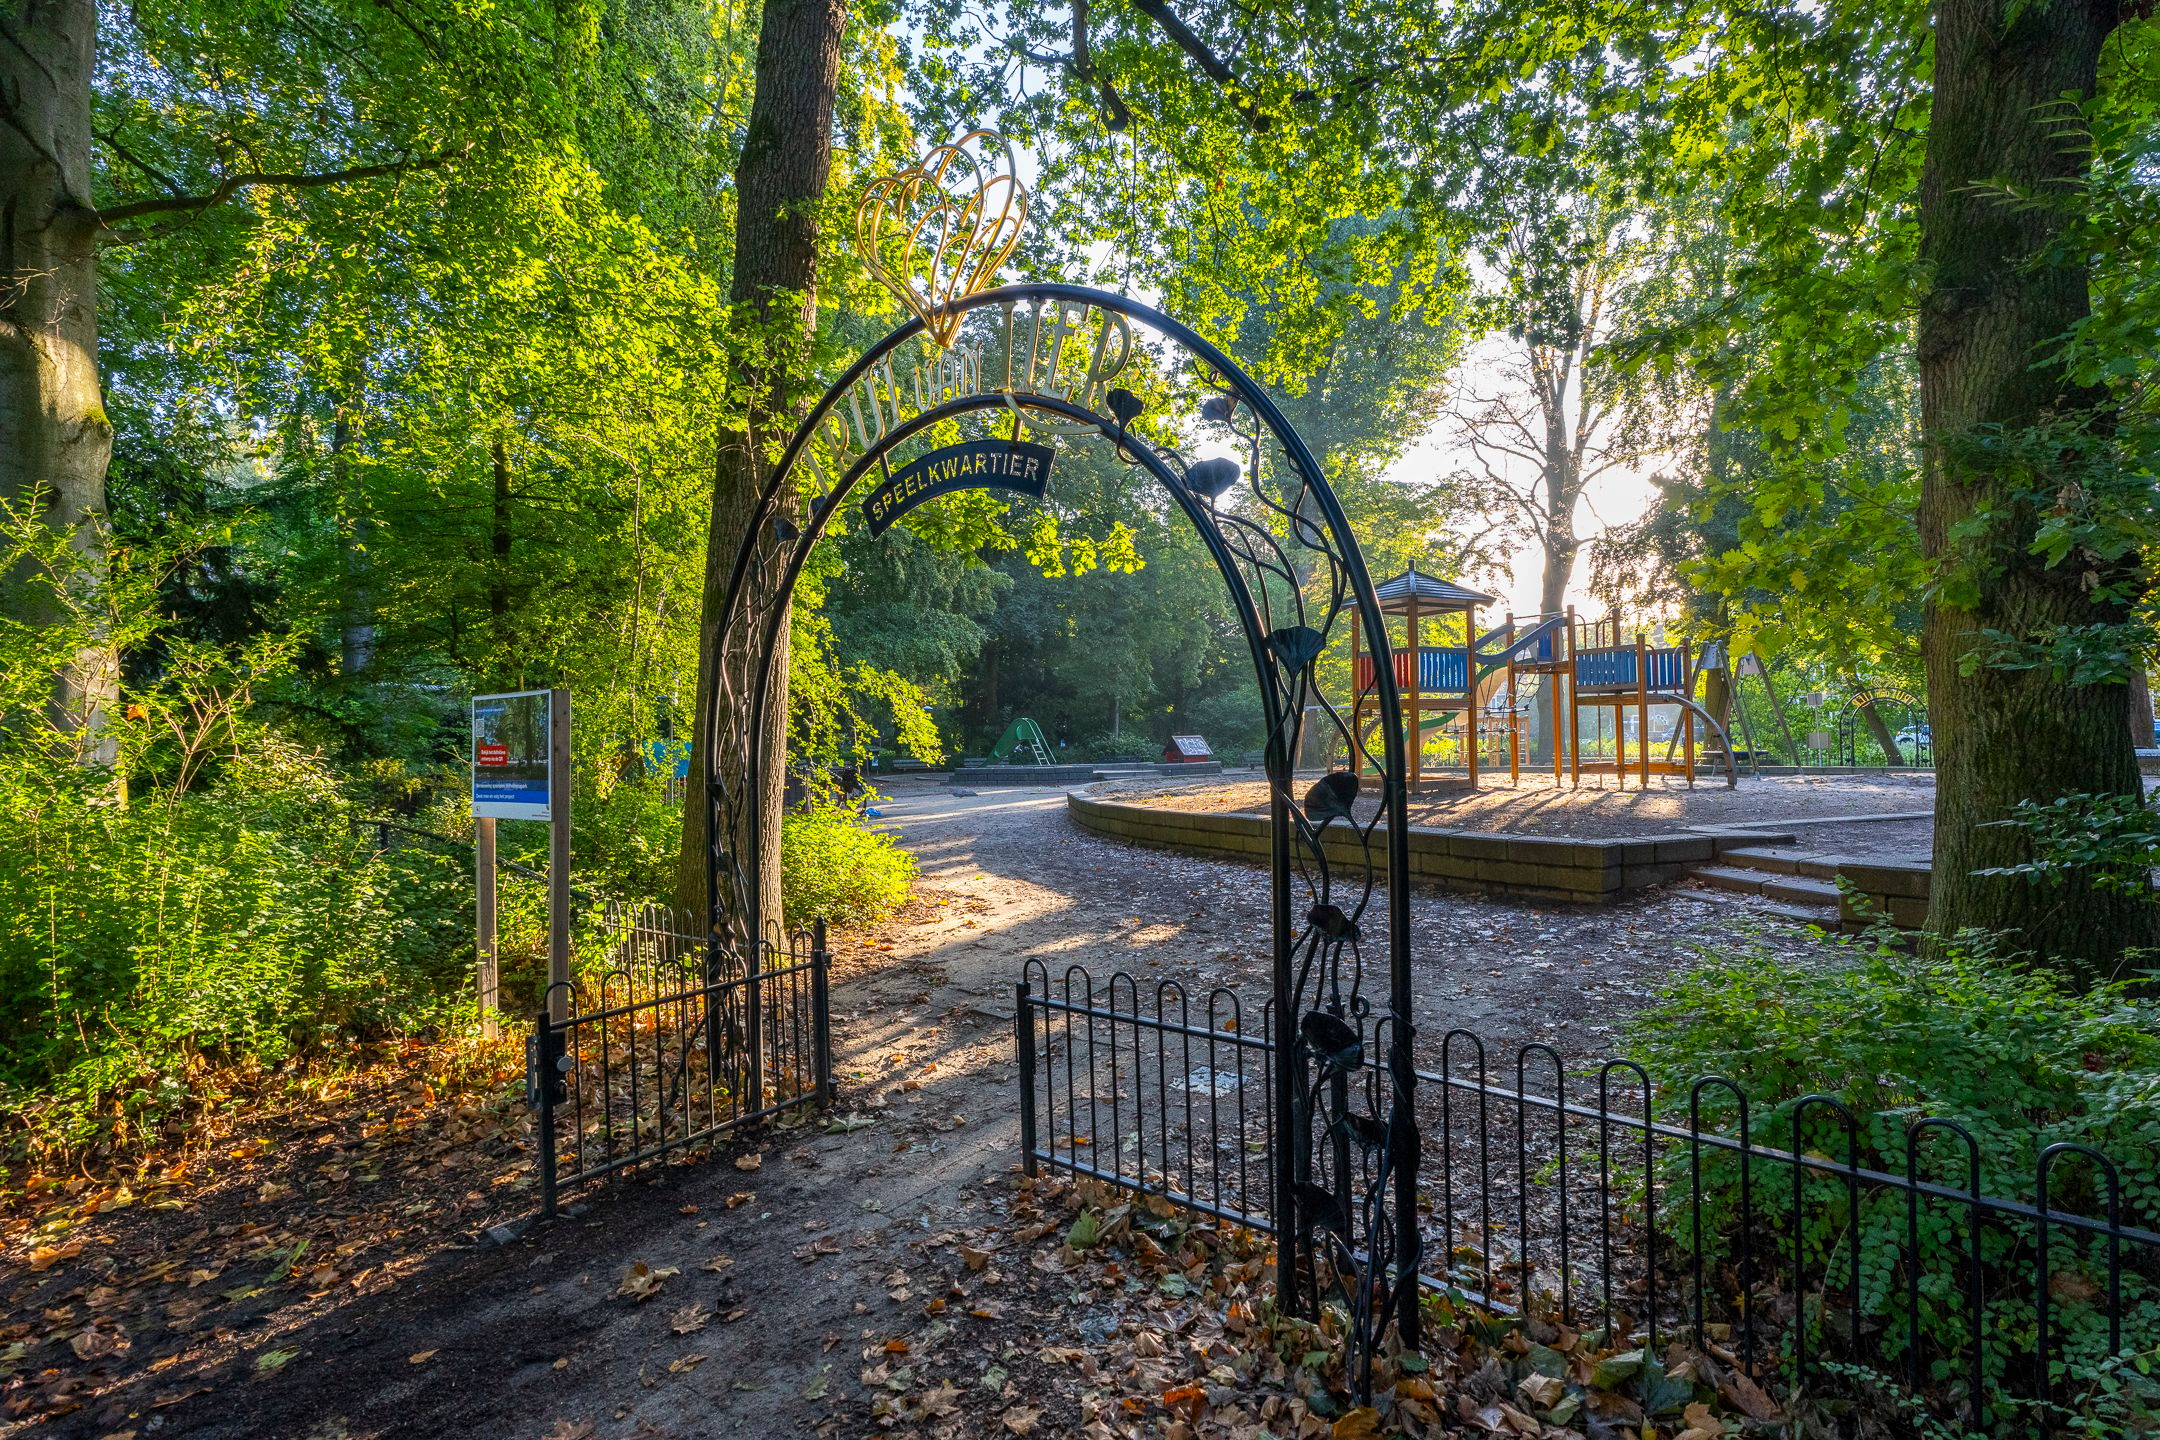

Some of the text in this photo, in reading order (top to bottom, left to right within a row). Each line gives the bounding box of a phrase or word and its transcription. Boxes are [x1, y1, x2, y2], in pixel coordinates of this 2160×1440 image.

[794, 350, 902, 498] TRUI
[993, 300, 1131, 435] LIER
[872, 452, 1039, 521] SPEELKWARTIER
